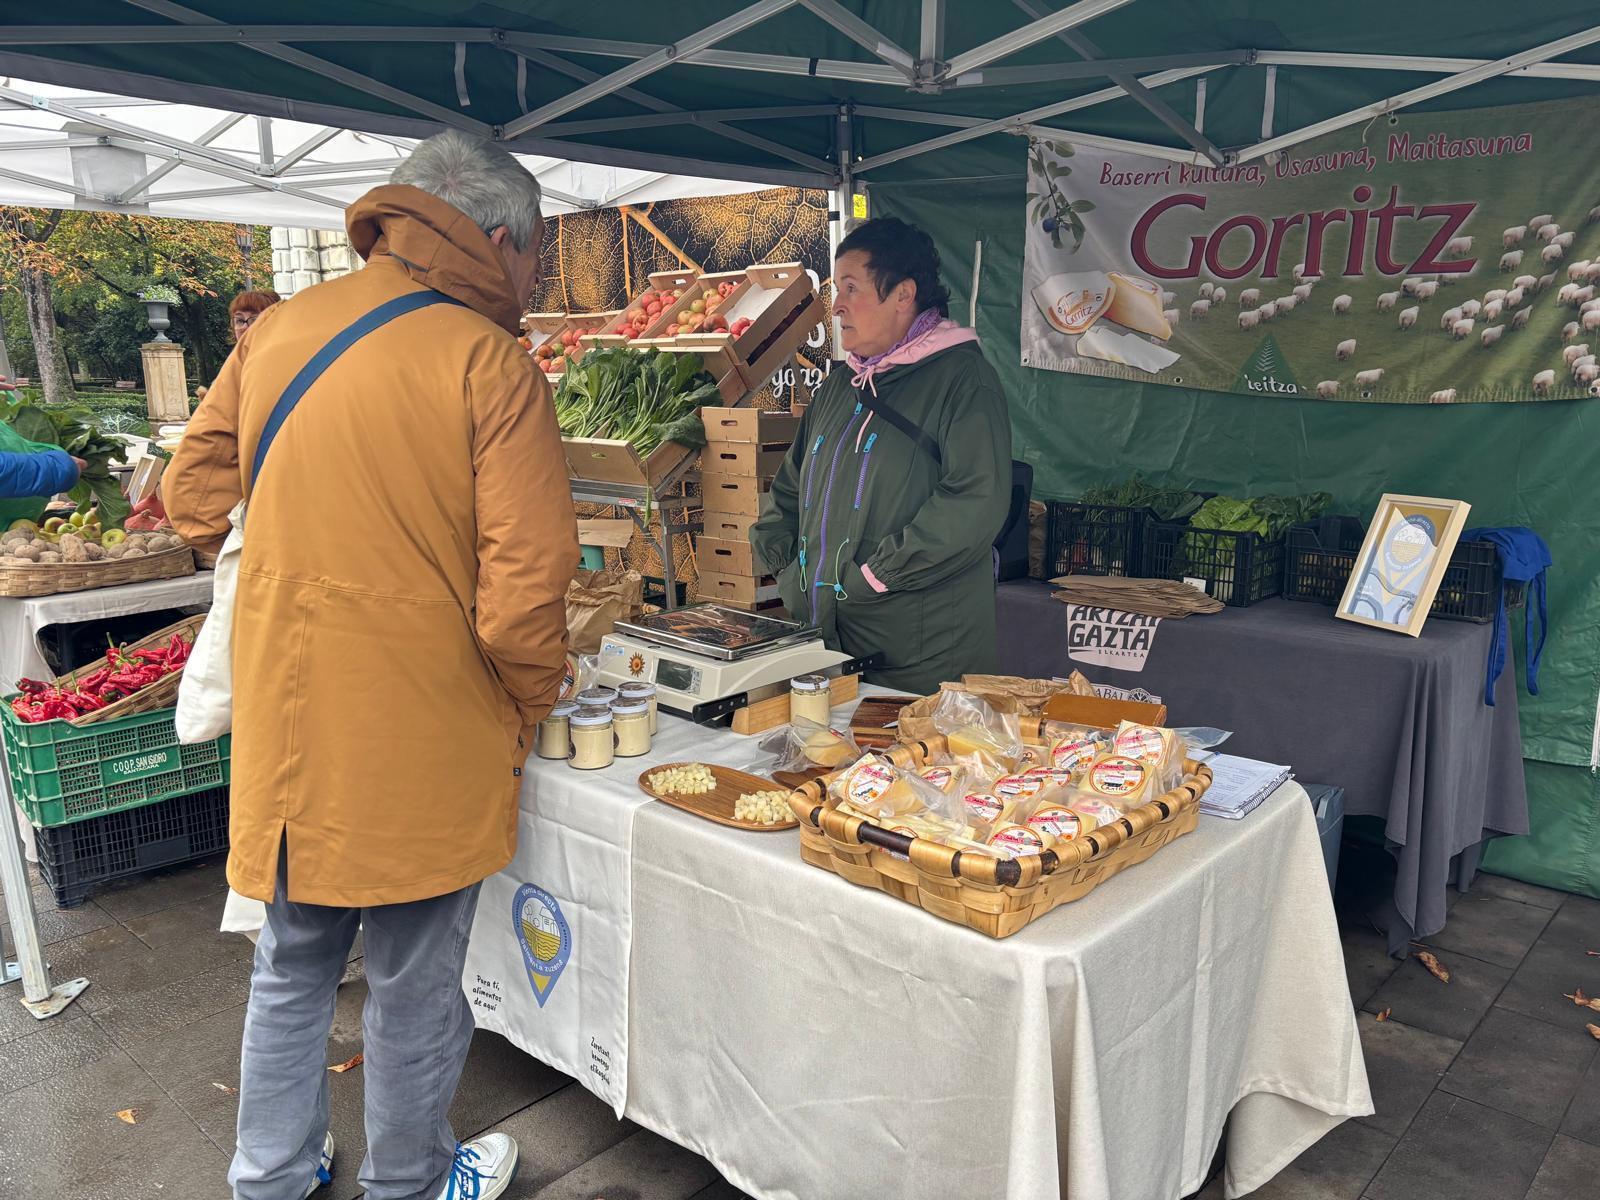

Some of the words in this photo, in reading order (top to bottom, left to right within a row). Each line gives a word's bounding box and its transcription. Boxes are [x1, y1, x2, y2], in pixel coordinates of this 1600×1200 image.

[1100, 162, 1171, 186] Baserri
[1179, 162, 1266, 189] kultura,
[1275, 147, 1376, 178] Osasuna,
[1387, 132, 1533, 163] Maitasuna
[1130, 185, 1479, 279] Gorritz
[1069, 623, 1149, 650] GAZTA
[1099, 650, 1145, 658] ELKARTEA
[477, 974, 490, 987] Para
[472, 986, 501, 1003] alimentos
[474, 997, 481, 1006] de
